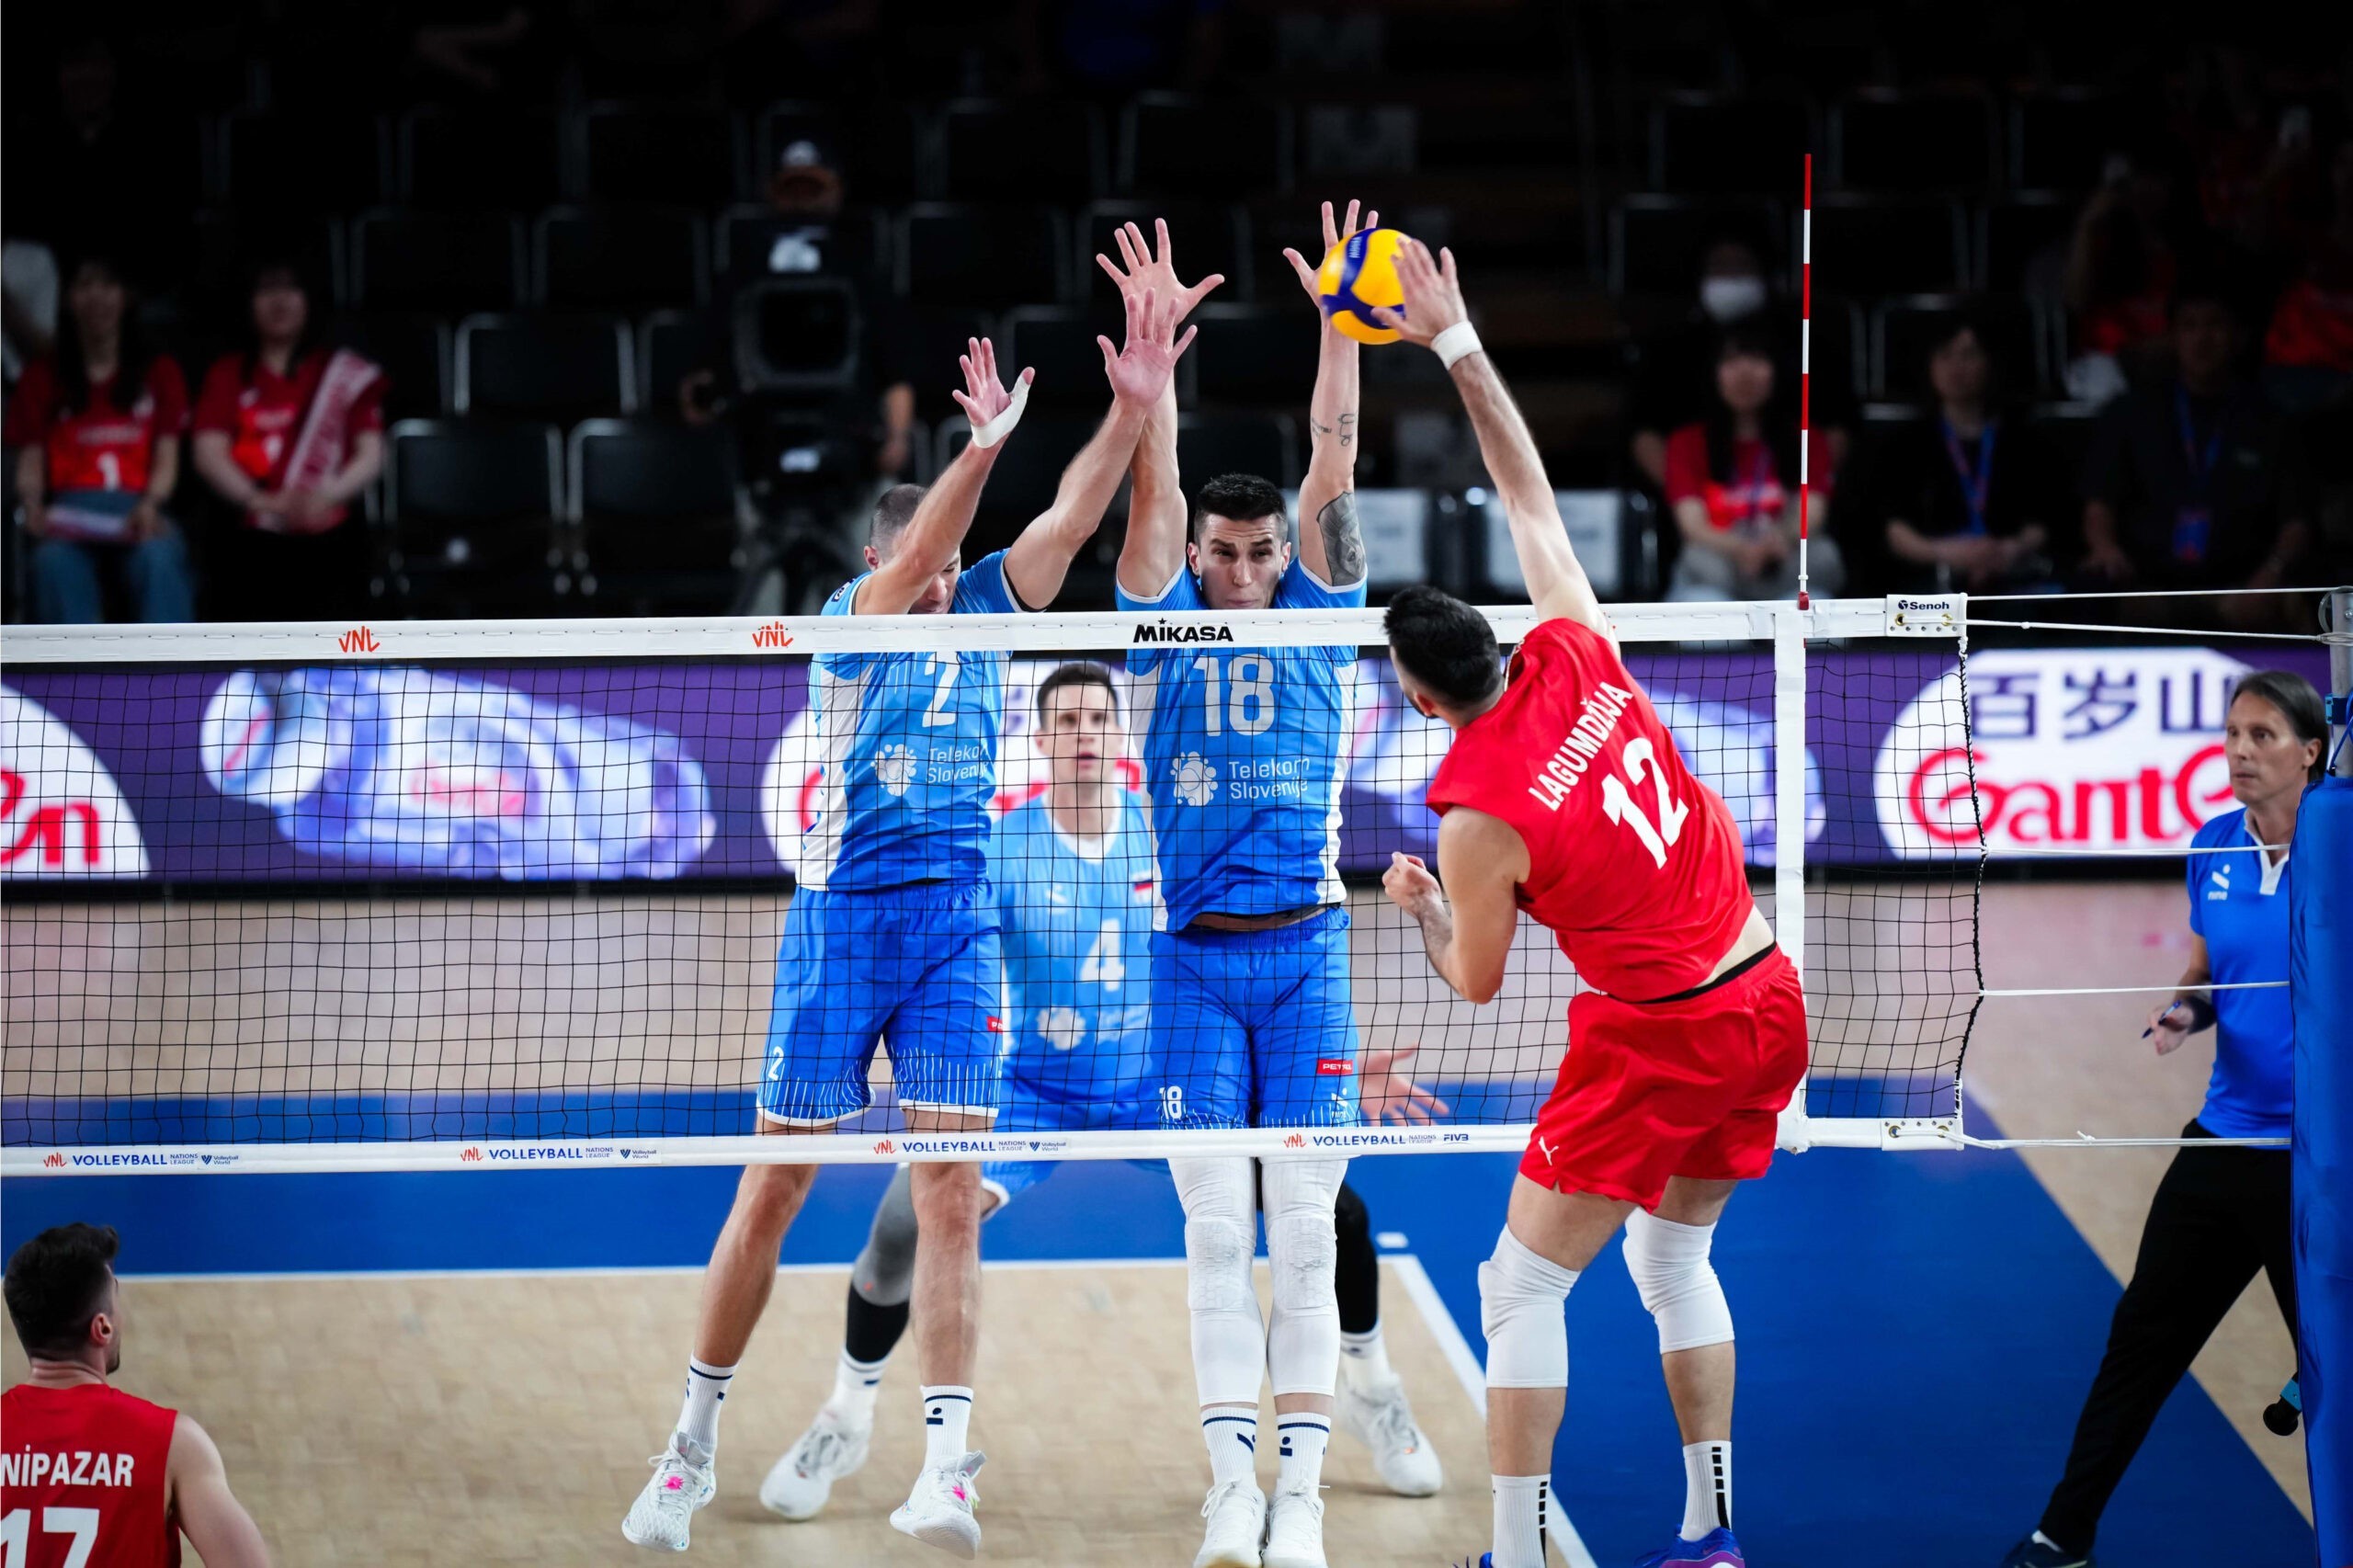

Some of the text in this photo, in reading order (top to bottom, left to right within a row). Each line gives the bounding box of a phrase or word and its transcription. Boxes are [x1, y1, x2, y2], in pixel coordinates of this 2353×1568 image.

[1909, 601, 1949, 610] Senoh
[338, 625, 380, 653] VNL
[752, 620, 793, 647] VNL
[1132, 617, 1234, 643] MIKASA
[922, 652, 961, 728] 2
[1192, 653, 1275, 736] 18
[1965, 669, 2234, 739] 百岁山
[1228, 757, 1310, 780] Telekom
[1230, 777, 1309, 801] Slovenije
[1601, 737, 1689, 869] 12
[1081, 918, 1125, 992] 4
[768, 1045, 784, 1081] 2
[1159, 1085, 1182, 1119] 18
[489, 1148, 583, 1160] VOLLEYBALL
[903, 1141, 996, 1153] VOLLEYBALL
[1313, 1135, 1405, 1146] VOLLEYBALL
[73, 1154, 167, 1166] VOLLEYBALL
[1, 1506, 100, 1568] 17
